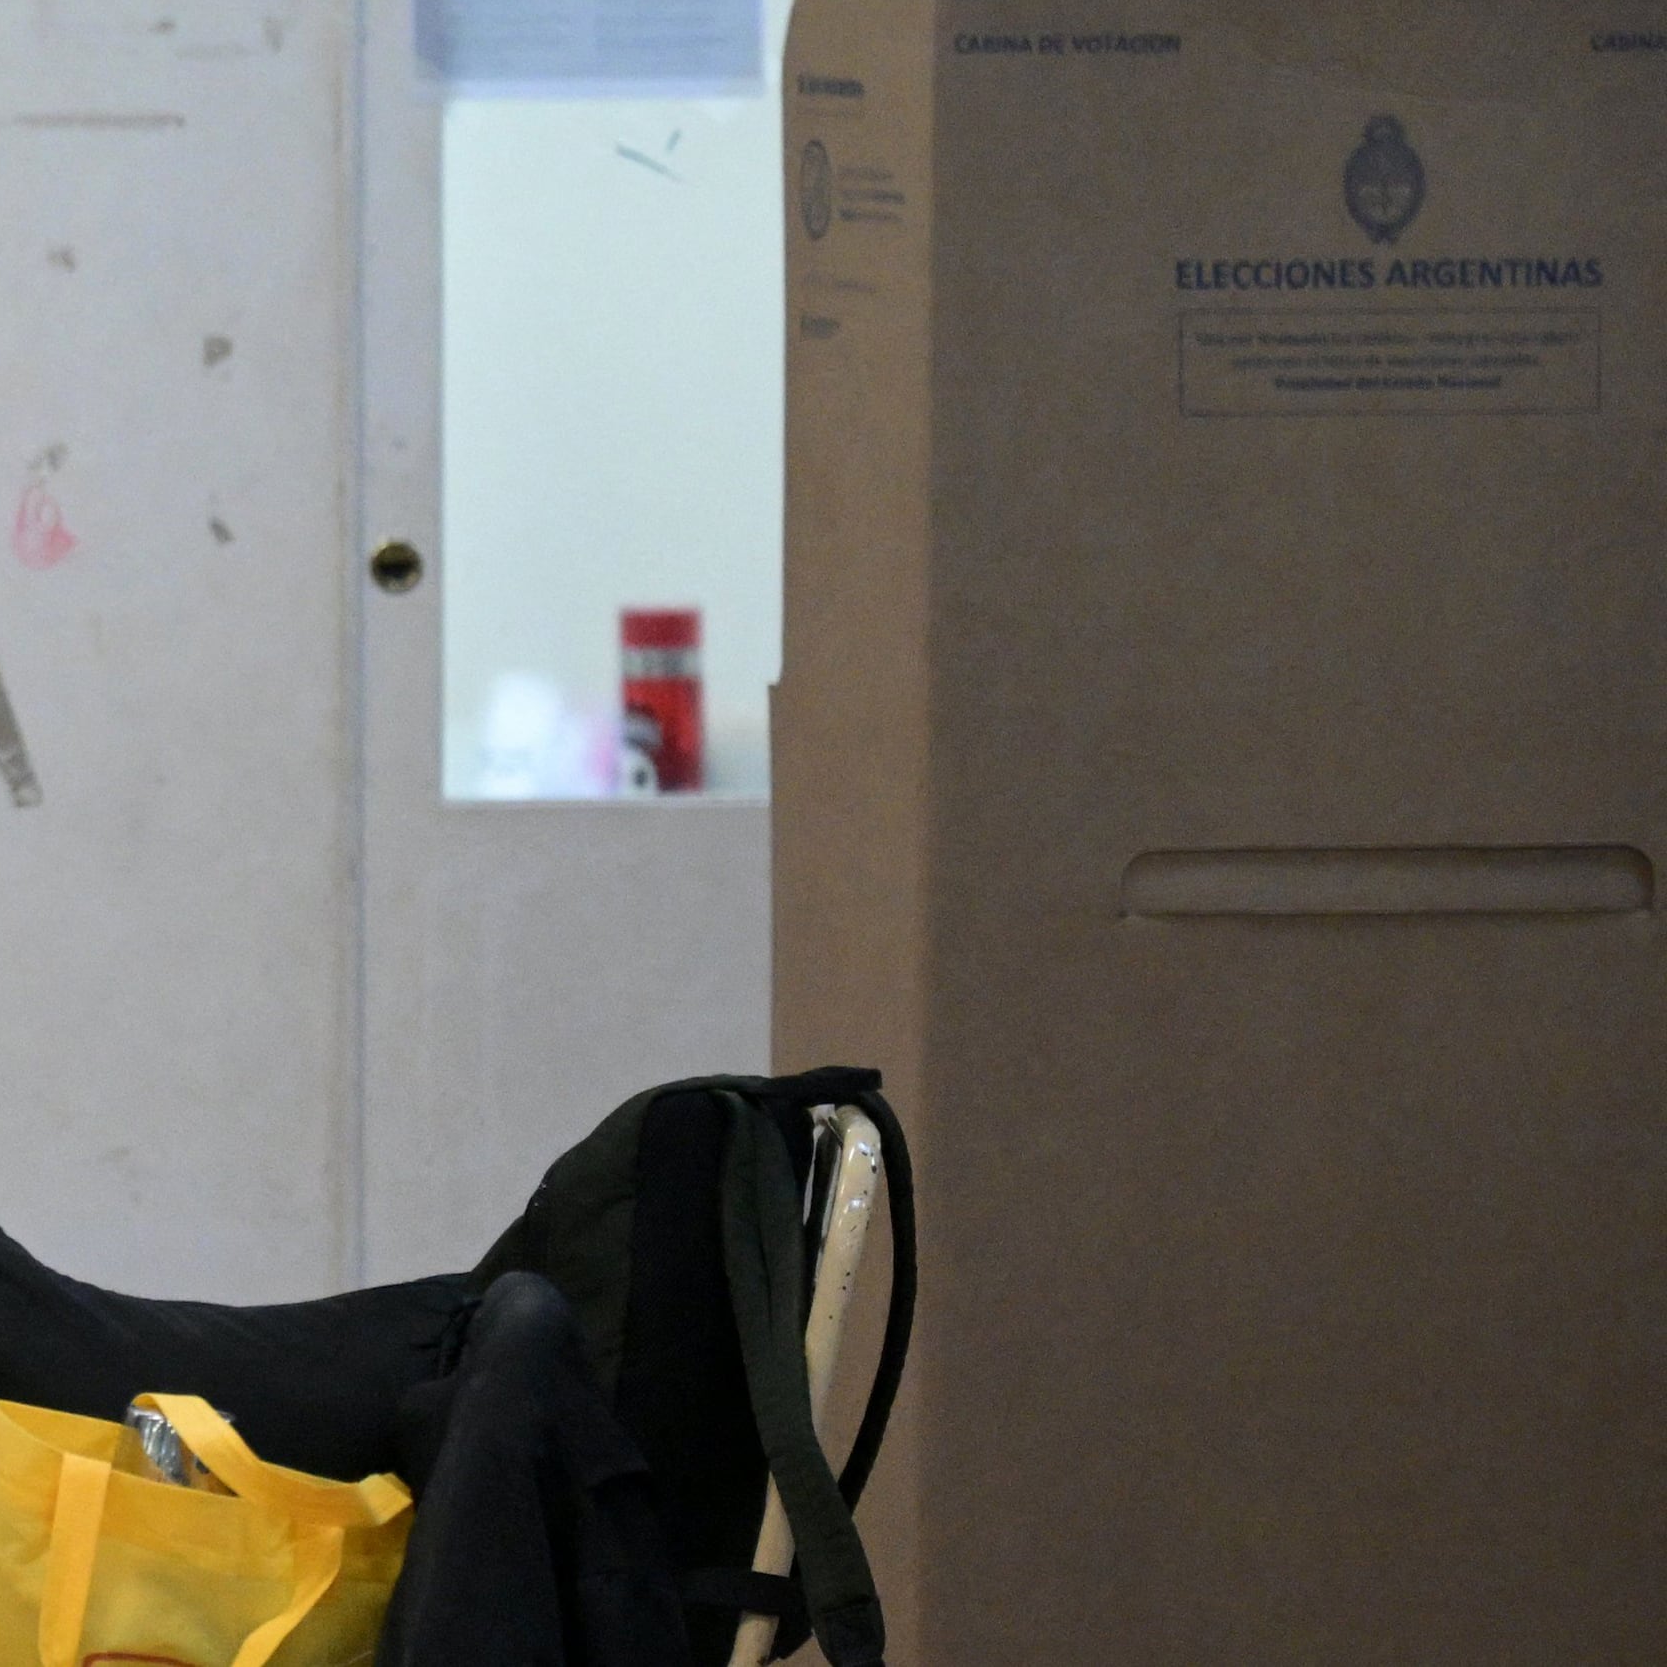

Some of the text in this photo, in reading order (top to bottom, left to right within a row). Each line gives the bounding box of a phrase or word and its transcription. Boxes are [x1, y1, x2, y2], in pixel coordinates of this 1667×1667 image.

[954, 33, 1033, 53] CABINA
[1038, 33, 1065, 53] DE
[1175, 257, 1604, 289] ELECCIONES ARGENTINAS
